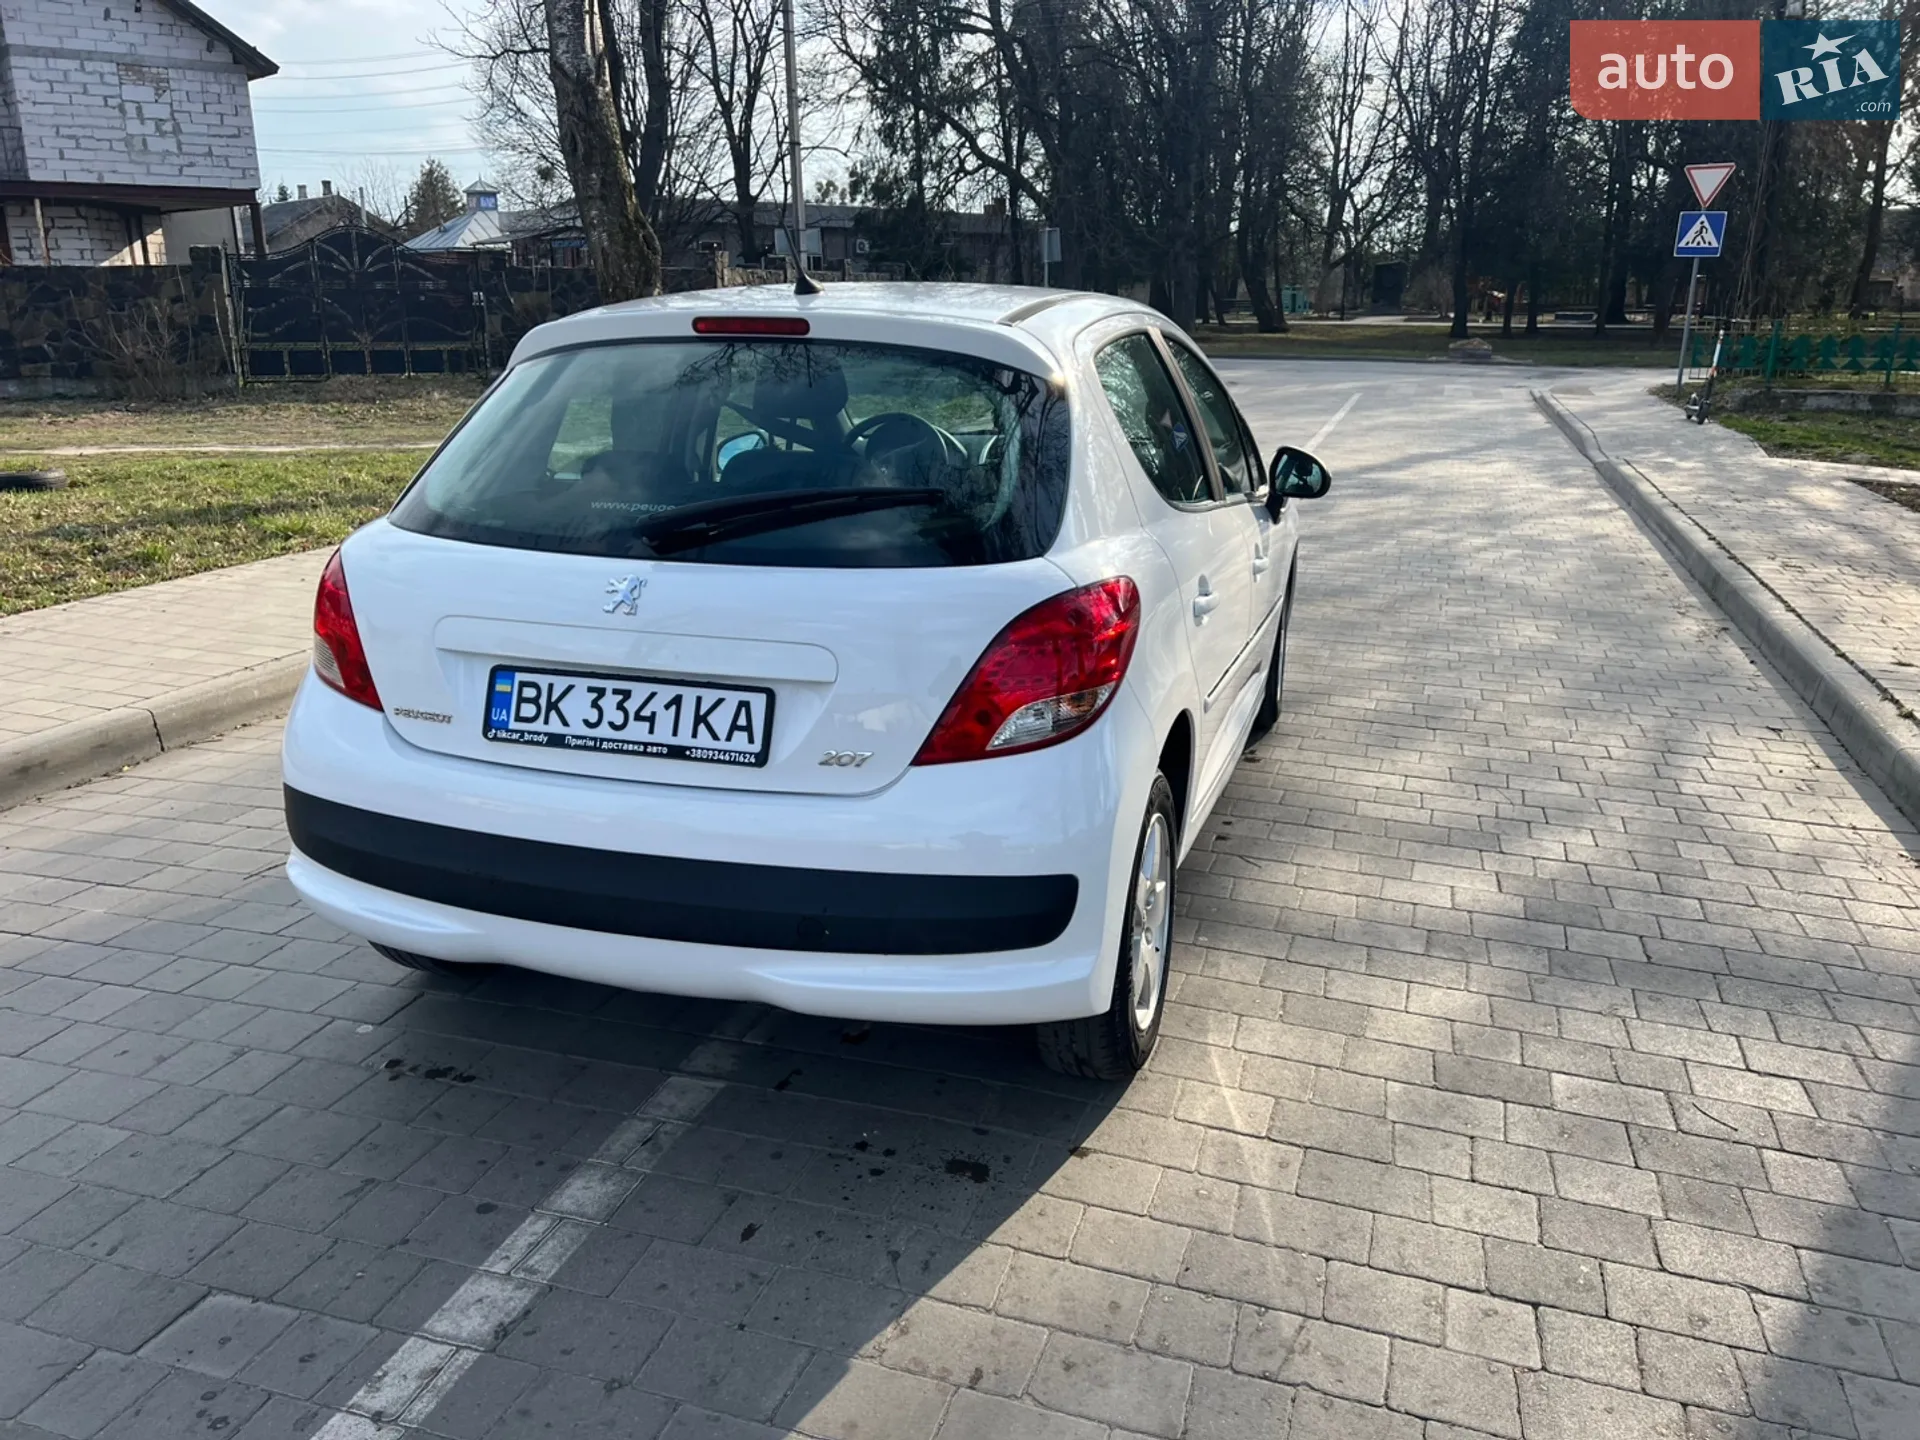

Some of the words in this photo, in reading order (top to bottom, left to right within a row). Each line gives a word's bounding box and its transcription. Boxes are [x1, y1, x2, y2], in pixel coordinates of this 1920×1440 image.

[393, 707, 453, 724] PEUGEOT
[492, 707, 508, 722] UA
[601, 740, 645, 752] доставка
[646, 745, 669, 755] авто
[817, 750, 875, 768] 207
